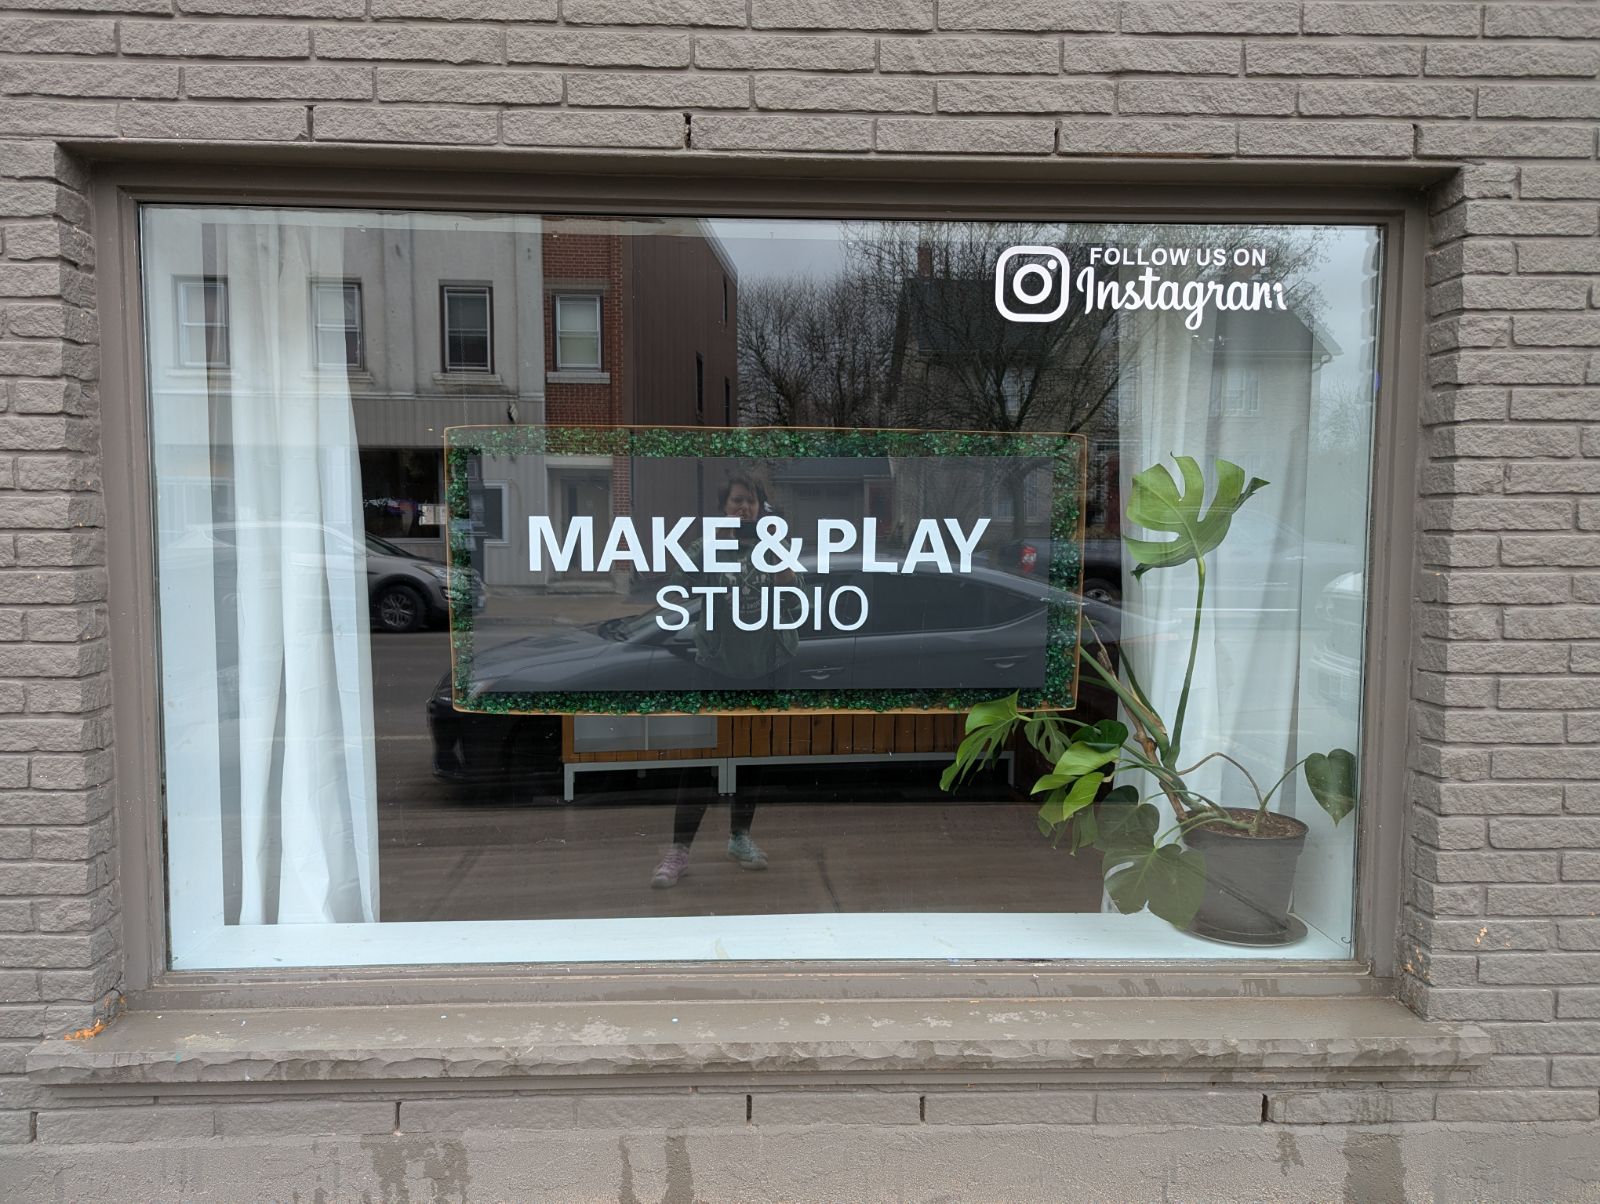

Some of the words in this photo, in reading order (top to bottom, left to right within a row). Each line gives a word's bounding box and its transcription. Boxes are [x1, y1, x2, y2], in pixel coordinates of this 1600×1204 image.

[1089, 247, 1190, 266] FOLLOW
[1196, 248, 1227, 266] US
[1233, 248, 1266, 267] ON
[1076, 266, 1288, 331] Instagram
[655, 585, 869, 631] STUDIO
